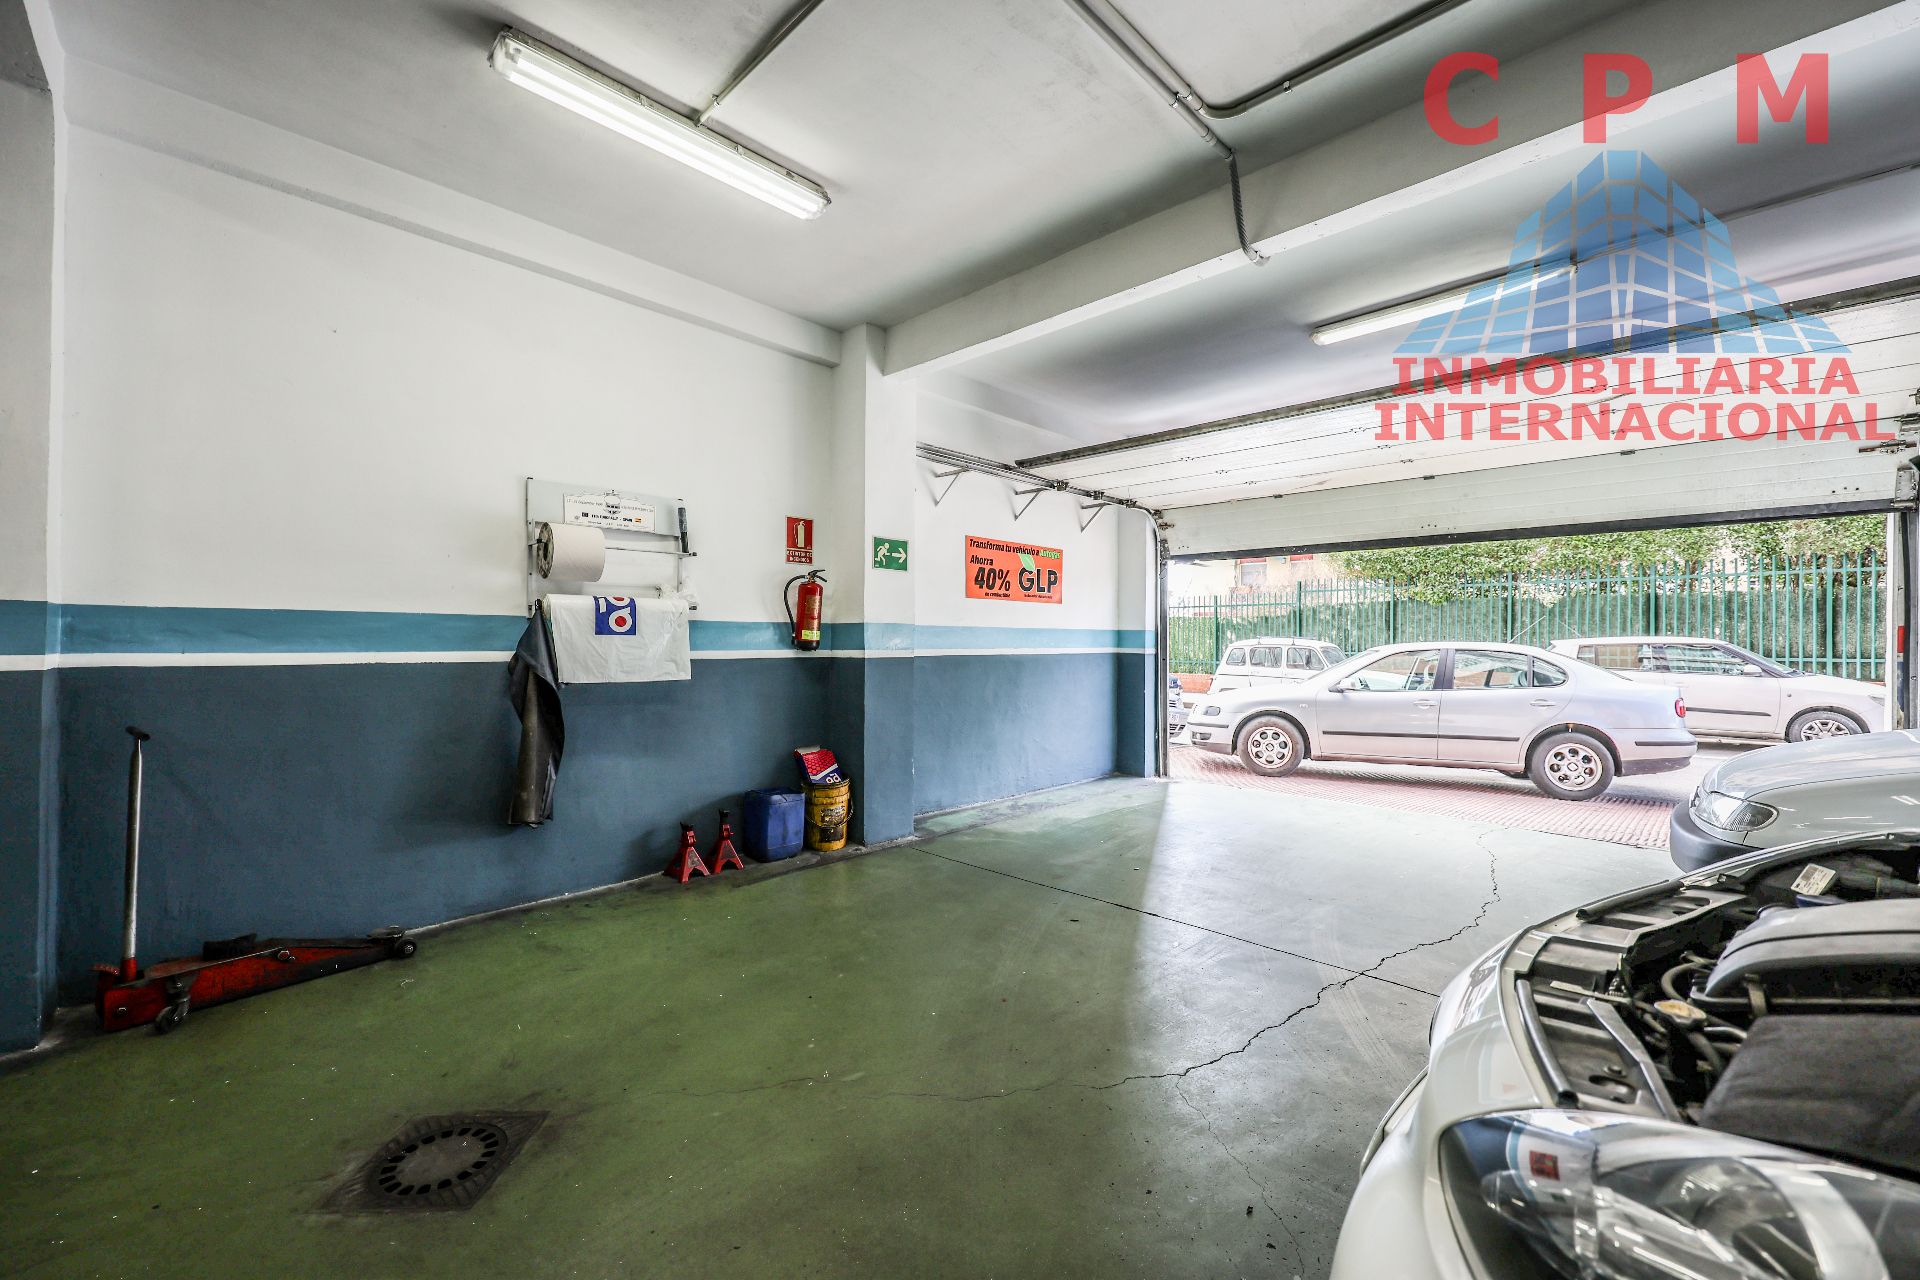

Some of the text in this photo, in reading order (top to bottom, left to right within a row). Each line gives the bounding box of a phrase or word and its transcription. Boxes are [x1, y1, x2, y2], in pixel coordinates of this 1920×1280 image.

[970, 539, 1004, 551] Transforma
[1005, 544, 1012, 553] tu
[970, 555, 994, 566] Ahorra
[974, 567, 1058, 593] 40% GLP
